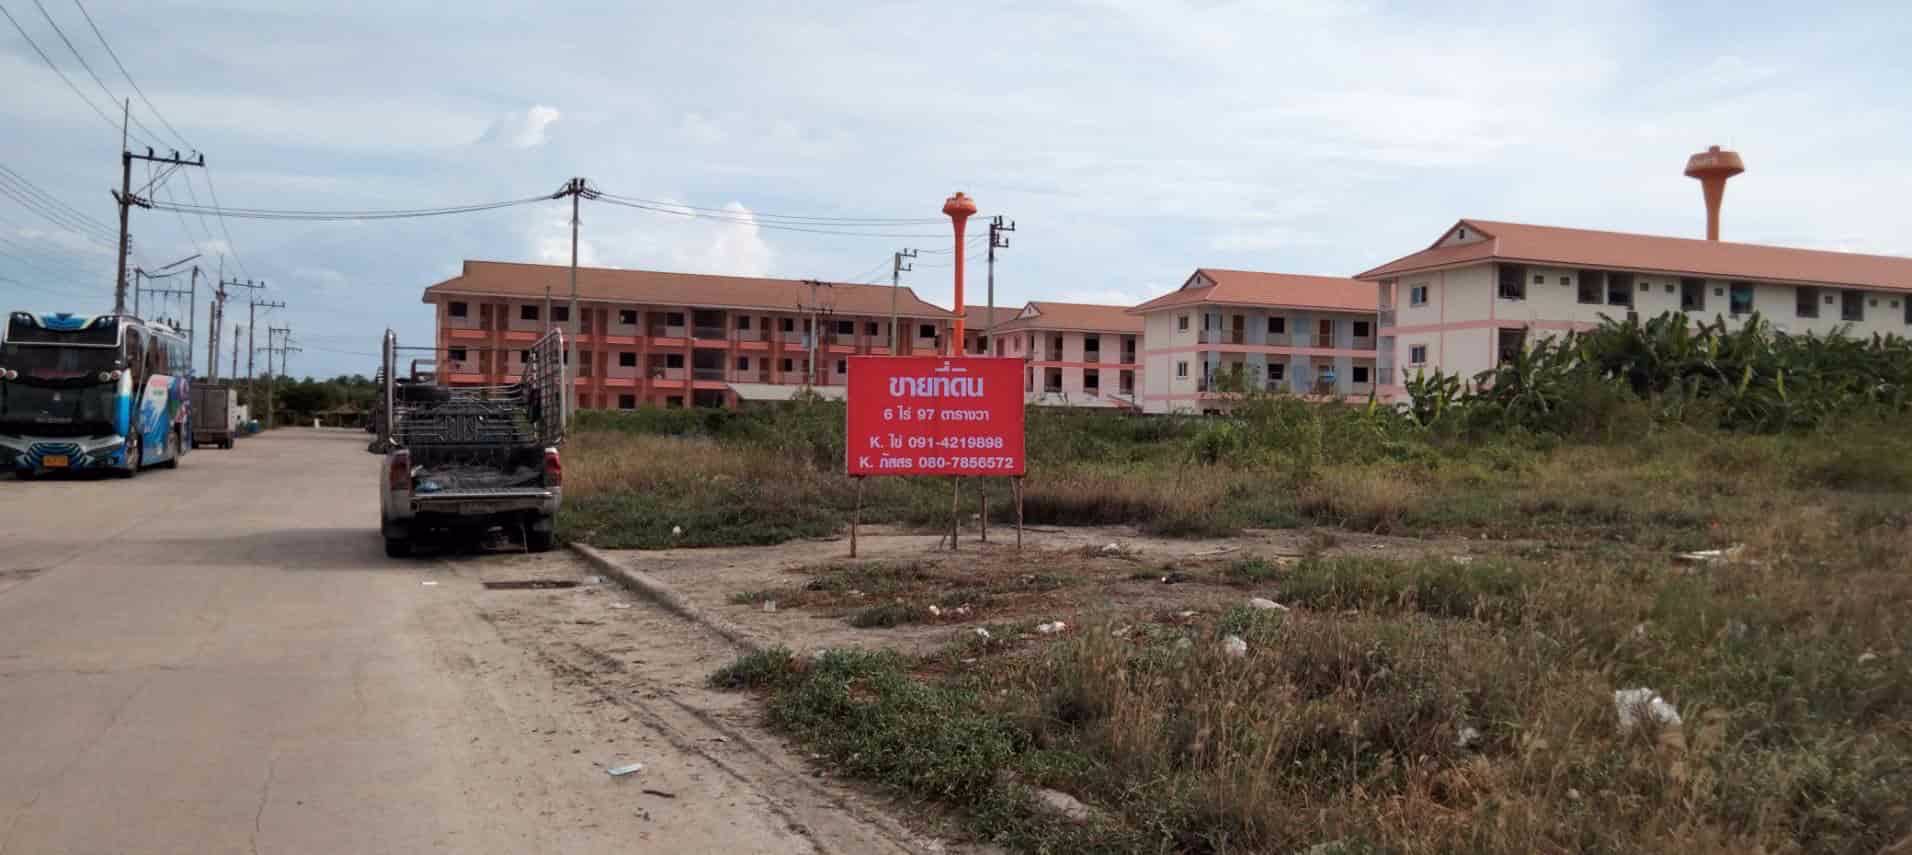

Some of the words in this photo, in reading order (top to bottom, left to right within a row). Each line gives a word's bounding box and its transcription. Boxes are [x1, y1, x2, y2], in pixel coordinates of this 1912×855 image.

[889, 361, 984, 397] ขายที่ดิน
[883, 408, 893, 421] 6
[897, 405, 911, 421] ไร่
[917, 408, 934, 421] 97
[941, 409, 990, 421] ตารางวา
[869, 435, 884, 449] K.
[859, 455, 873, 469] K.
[918, 456, 1014, 469] 080-7856572
